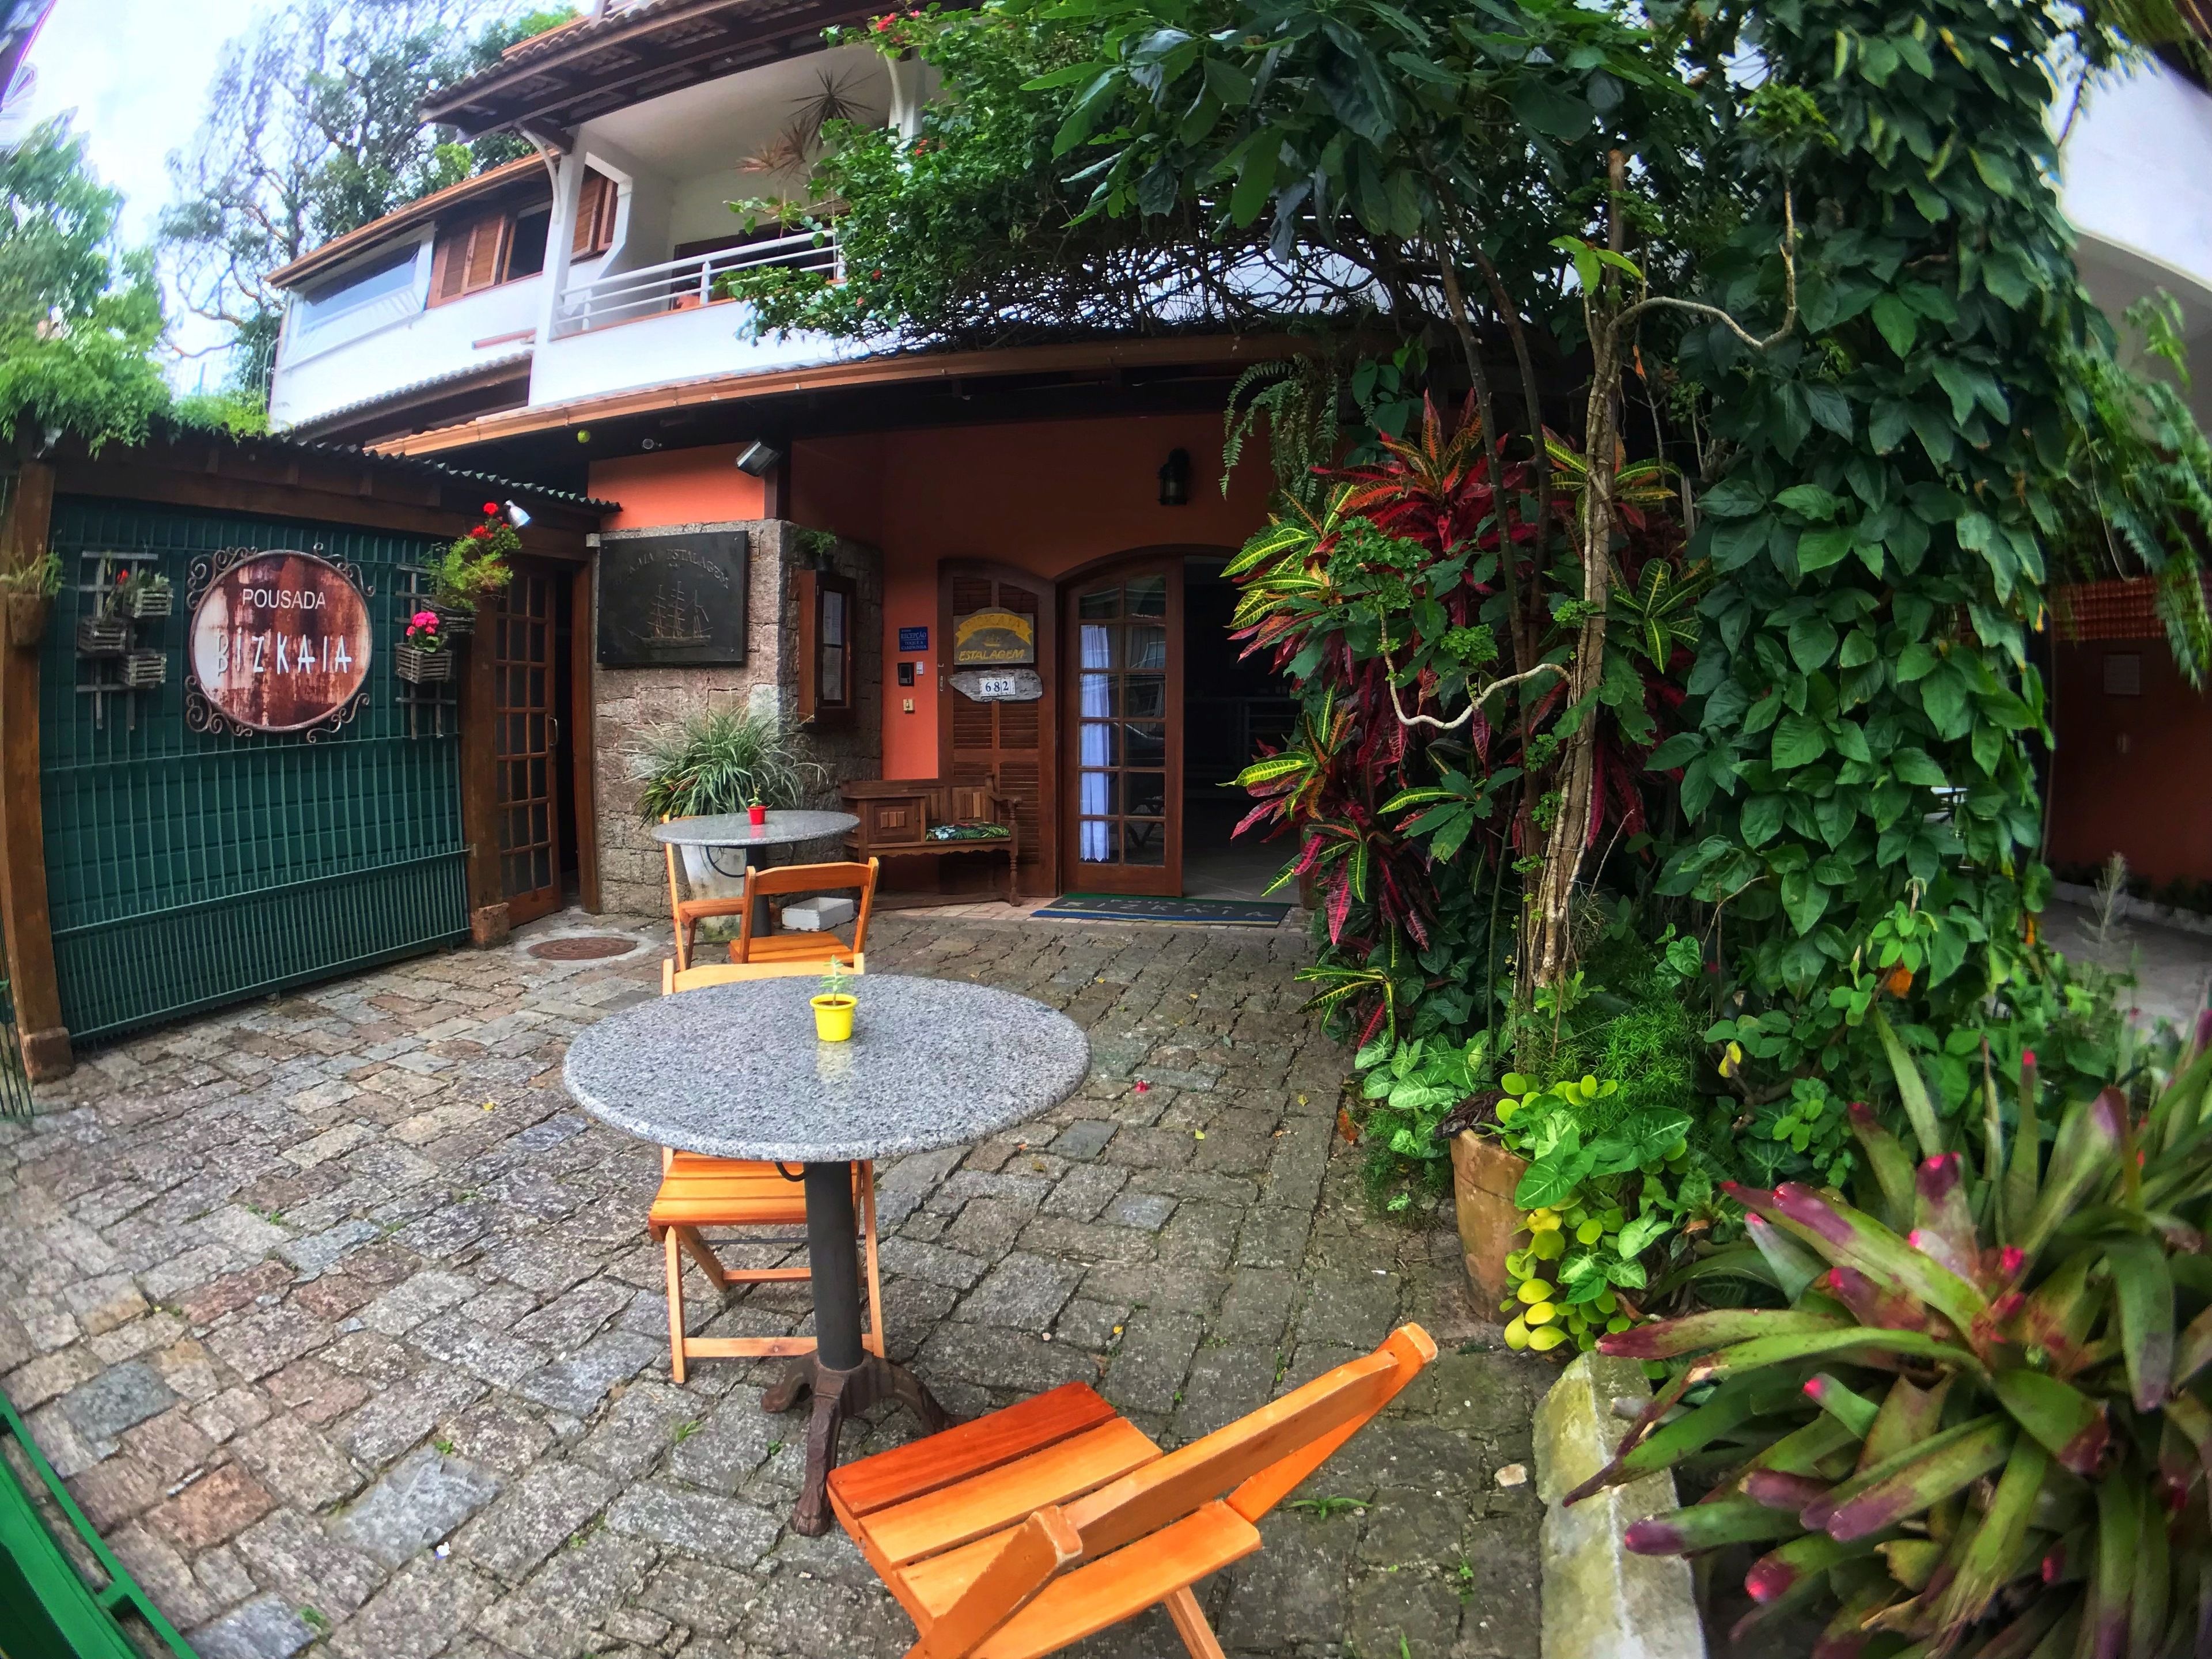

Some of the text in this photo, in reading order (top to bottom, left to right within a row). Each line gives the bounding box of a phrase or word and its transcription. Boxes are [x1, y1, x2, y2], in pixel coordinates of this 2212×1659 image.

[243, 589, 326, 609] POUSADA
[959, 649, 1025, 661] ESTALAGEM
[985, 680, 1009, 692] 682
